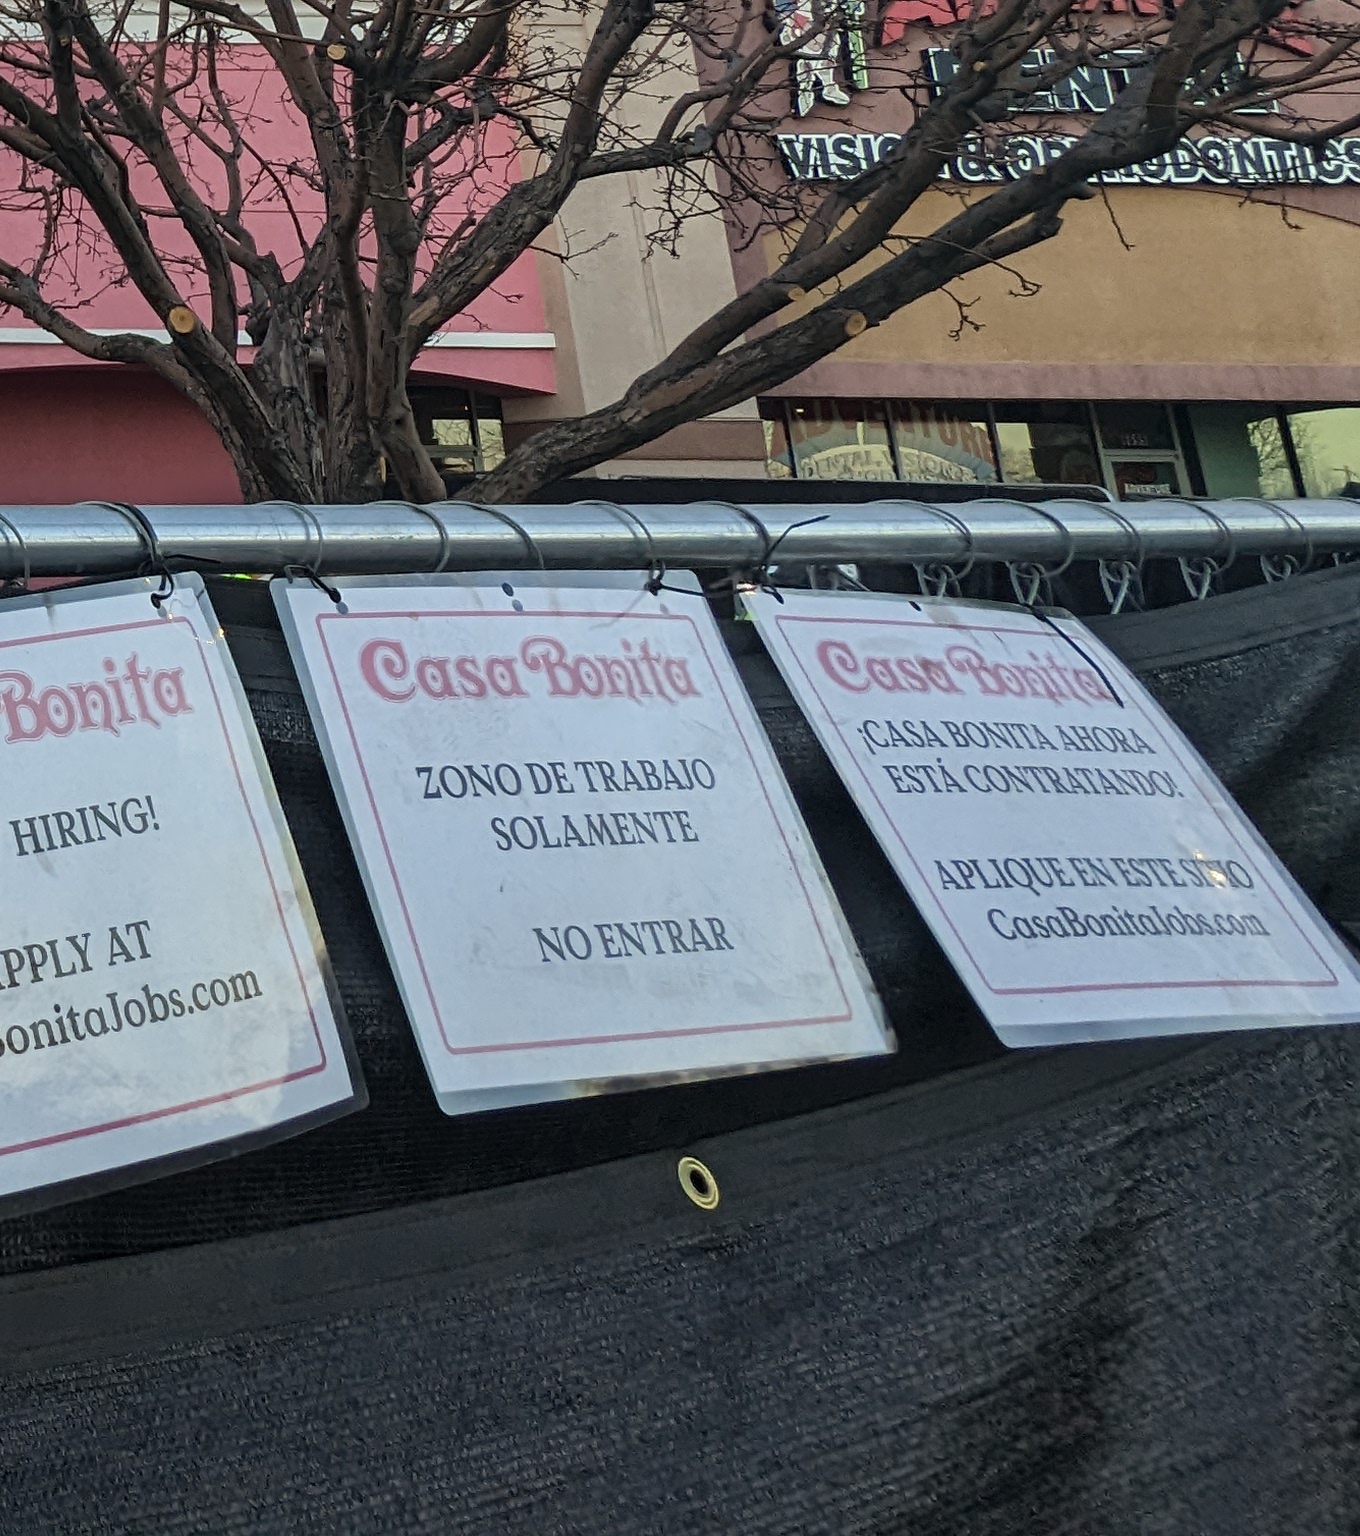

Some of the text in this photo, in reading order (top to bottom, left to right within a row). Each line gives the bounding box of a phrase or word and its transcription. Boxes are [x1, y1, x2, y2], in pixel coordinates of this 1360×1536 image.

[358, 634, 704, 706] Casa Bonita
[816, 638, 1117, 708] Casa Bonita
[856, 719, 1157, 756] ¡CASA BONITA AHORA
[415, 758, 717, 800] ZONO DE TRABAJO
[962, 764, 1185, 798] CONTRATANDO!
[8, 794, 161, 857] HIRING!
[490, 809, 700, 852] SOLAMENTE
[933, 857, 1076, 897] APLIQUE
[1067, 857, 1117, 889] EN
[1110, 857, 1185, 889] ESTE
[107, 919, 152, 967] AT
[532, 916, 735, 963] NO ENTRAR
[986, 905, 1271, 941] CasaBonitaJobs.com
